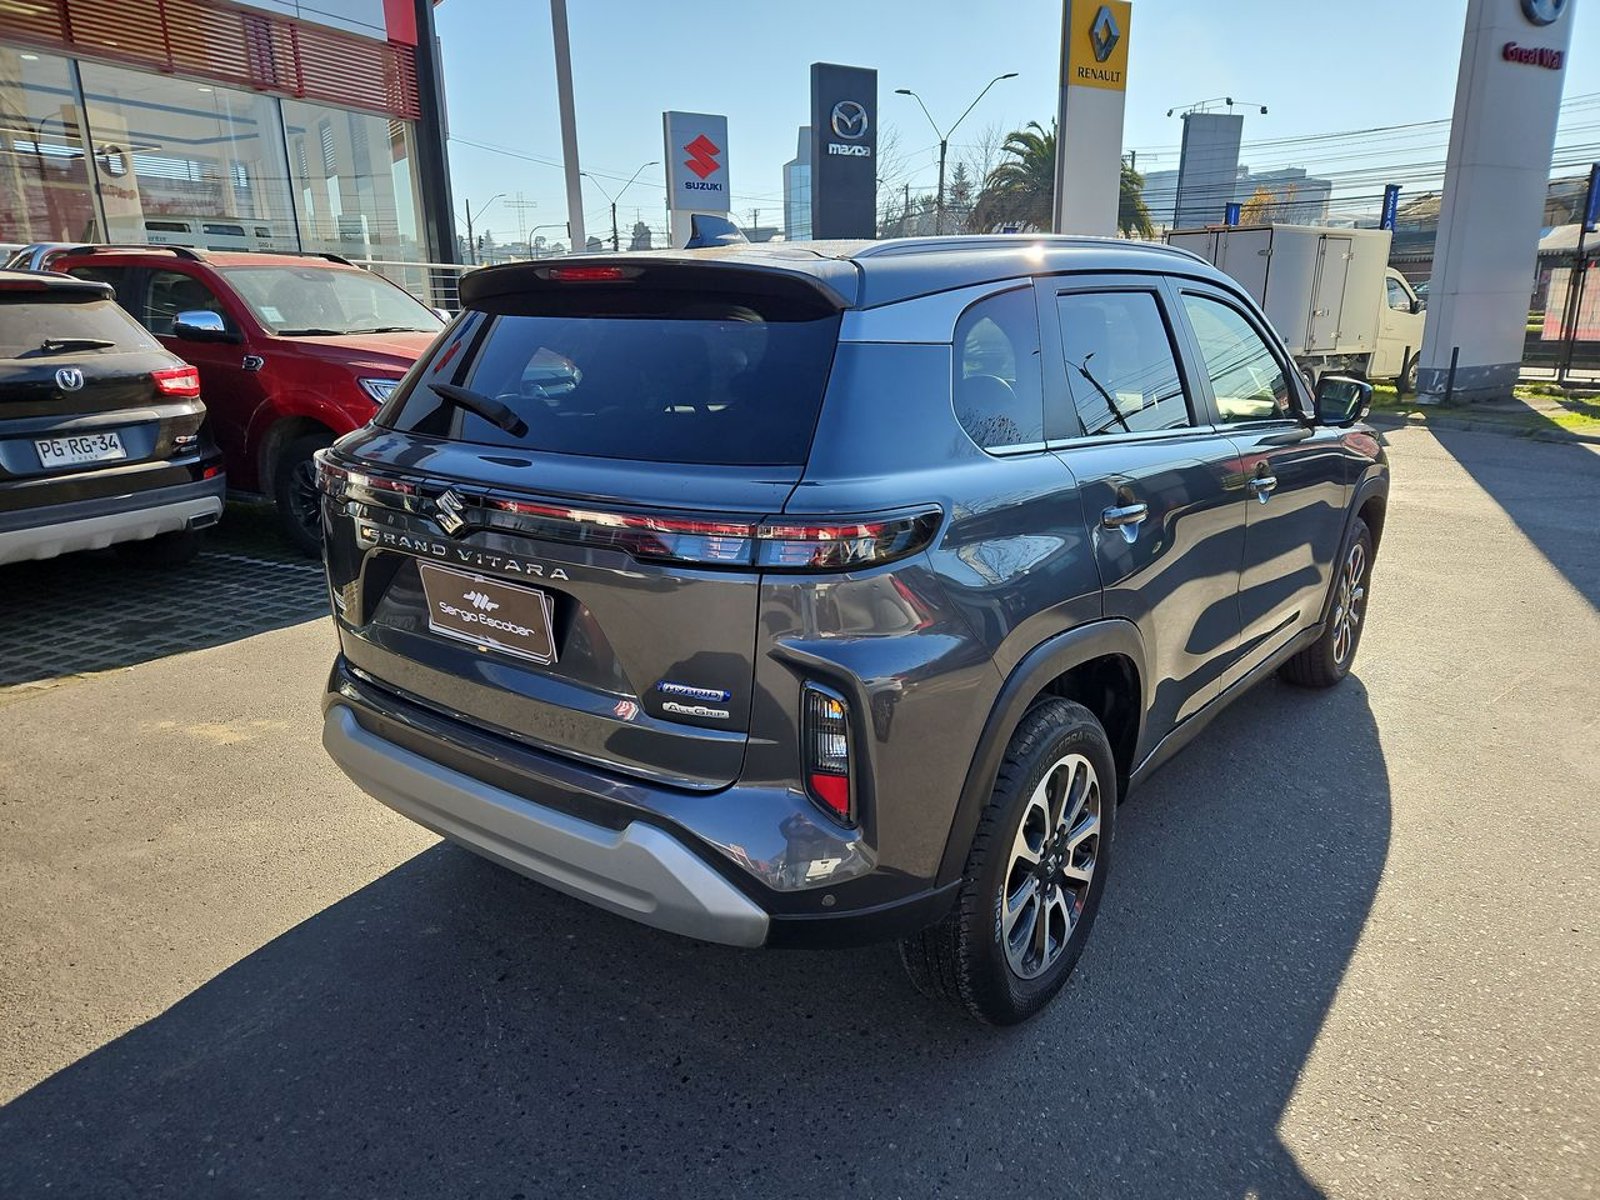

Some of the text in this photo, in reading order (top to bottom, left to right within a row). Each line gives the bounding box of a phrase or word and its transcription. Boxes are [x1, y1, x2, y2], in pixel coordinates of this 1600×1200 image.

[1502, 41, 1538, 65] Great
[1077, 65, 1121, 83] RENAULT
[828, 143, 870, 157] mazda
[685, 181, 722, 191] SUZUKI
[364, 526, 571, 582] GRAND VITARA
[478, 612, 536, 637] Escobar
[661, 683, 724, 701] HYBRID
